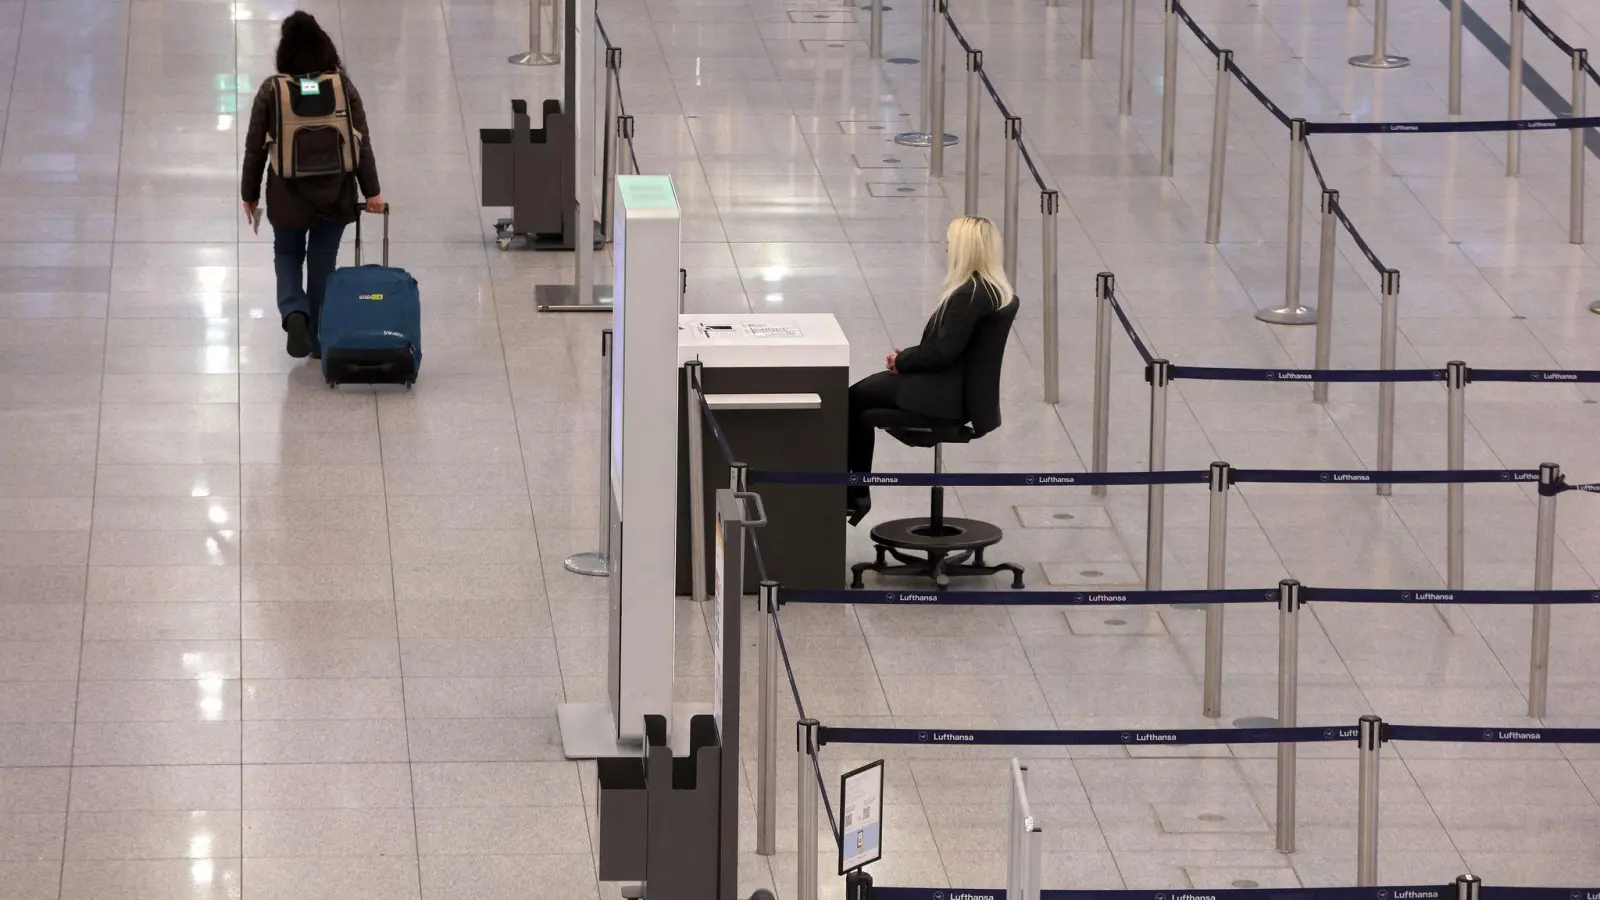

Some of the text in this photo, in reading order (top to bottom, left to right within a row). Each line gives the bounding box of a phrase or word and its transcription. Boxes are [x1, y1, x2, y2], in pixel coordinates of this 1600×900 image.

[1278, 372, 1312, 380] Lufthansa
[899, 594, 938, 602] Lufthansa
[1088, 594, 1127, 602] Lufthansa
[1415, 593, 1454, 601] Lufthansa
[933, 733, 974, 741] Lufthansa
[1136, 733, 1177, 741] Lufthansa
[1498, 731, 1541, 740] Lufthansa
[1393, 890, 1439, 899] Lufthansa
